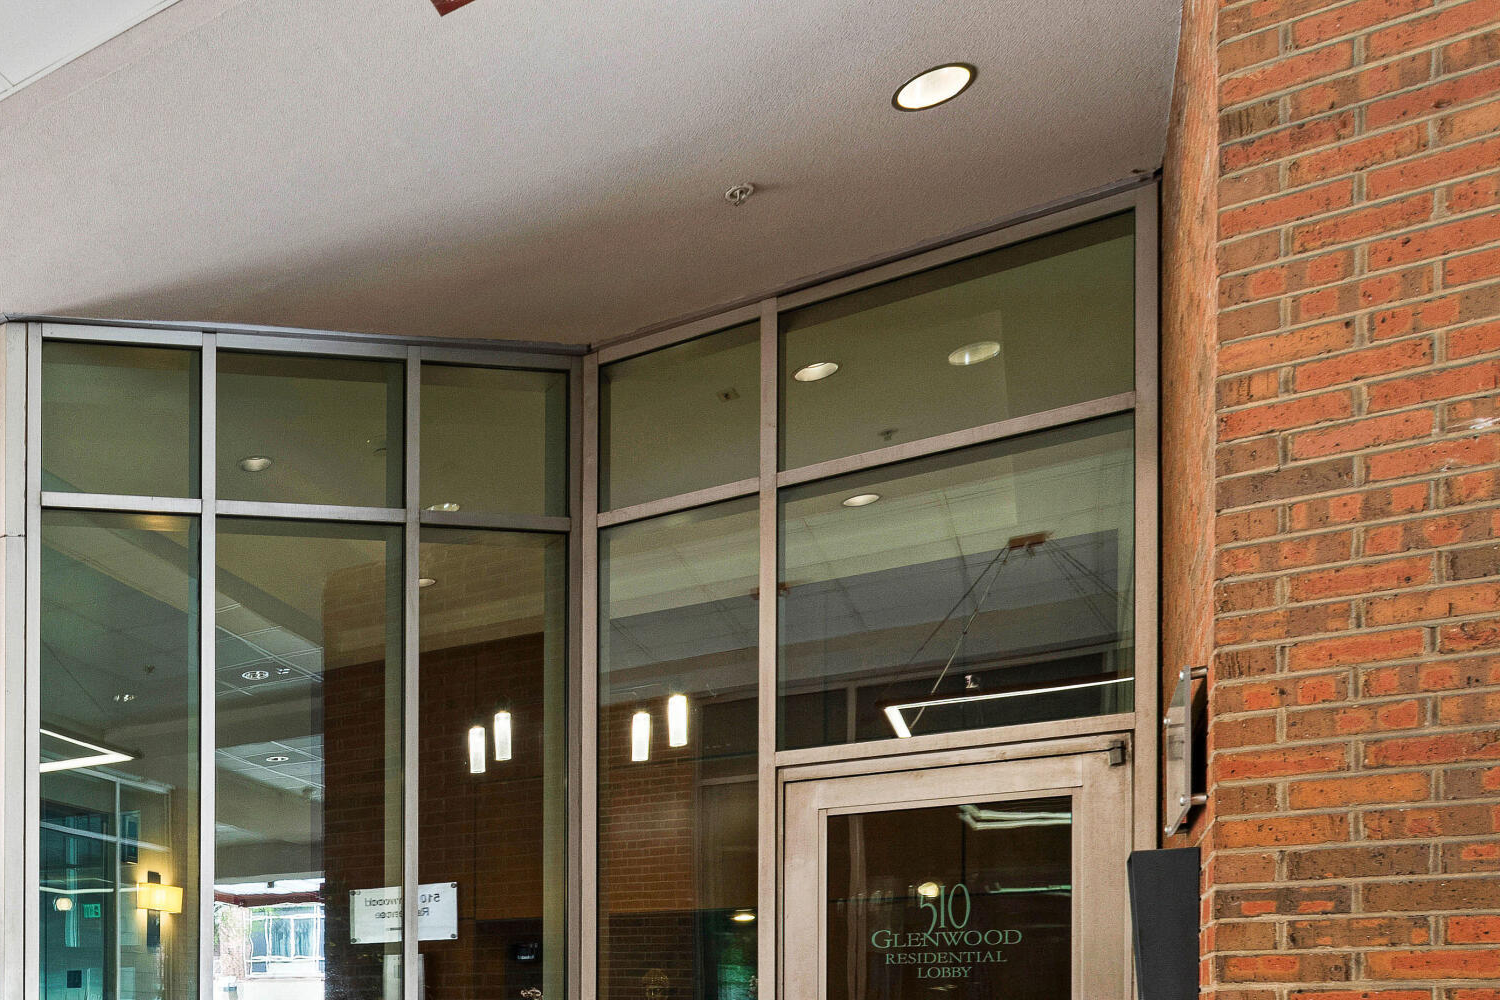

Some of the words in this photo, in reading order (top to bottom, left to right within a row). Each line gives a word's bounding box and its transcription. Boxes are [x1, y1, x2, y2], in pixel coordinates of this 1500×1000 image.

[919, 883, 971, 938] 510
[871, 929, 1023, 949] GLENWOOD
[885, 951, 1008, 965] RESIDENTIAL
[917, 966, 973, 979] LOBBY
